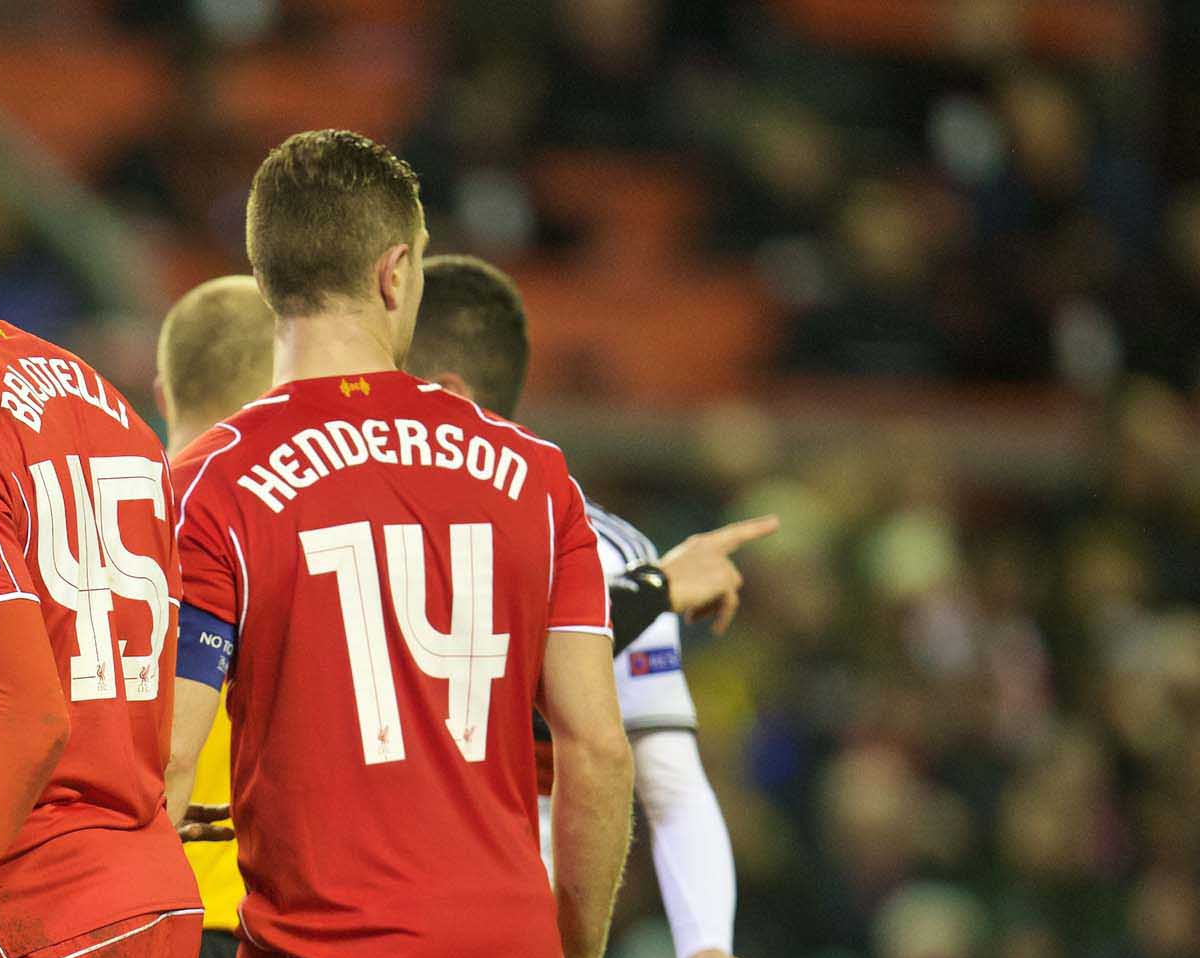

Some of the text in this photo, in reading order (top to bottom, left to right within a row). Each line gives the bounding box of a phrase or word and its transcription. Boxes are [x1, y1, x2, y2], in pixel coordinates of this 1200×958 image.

[1, 356, 129, 433] BALOTELLI
[238, 418, 527, 513] HENDERSON
[29, 454, 169, 702] 45
[200, 631, 223, 649] NO
[299, 521, 510, 766] 14
